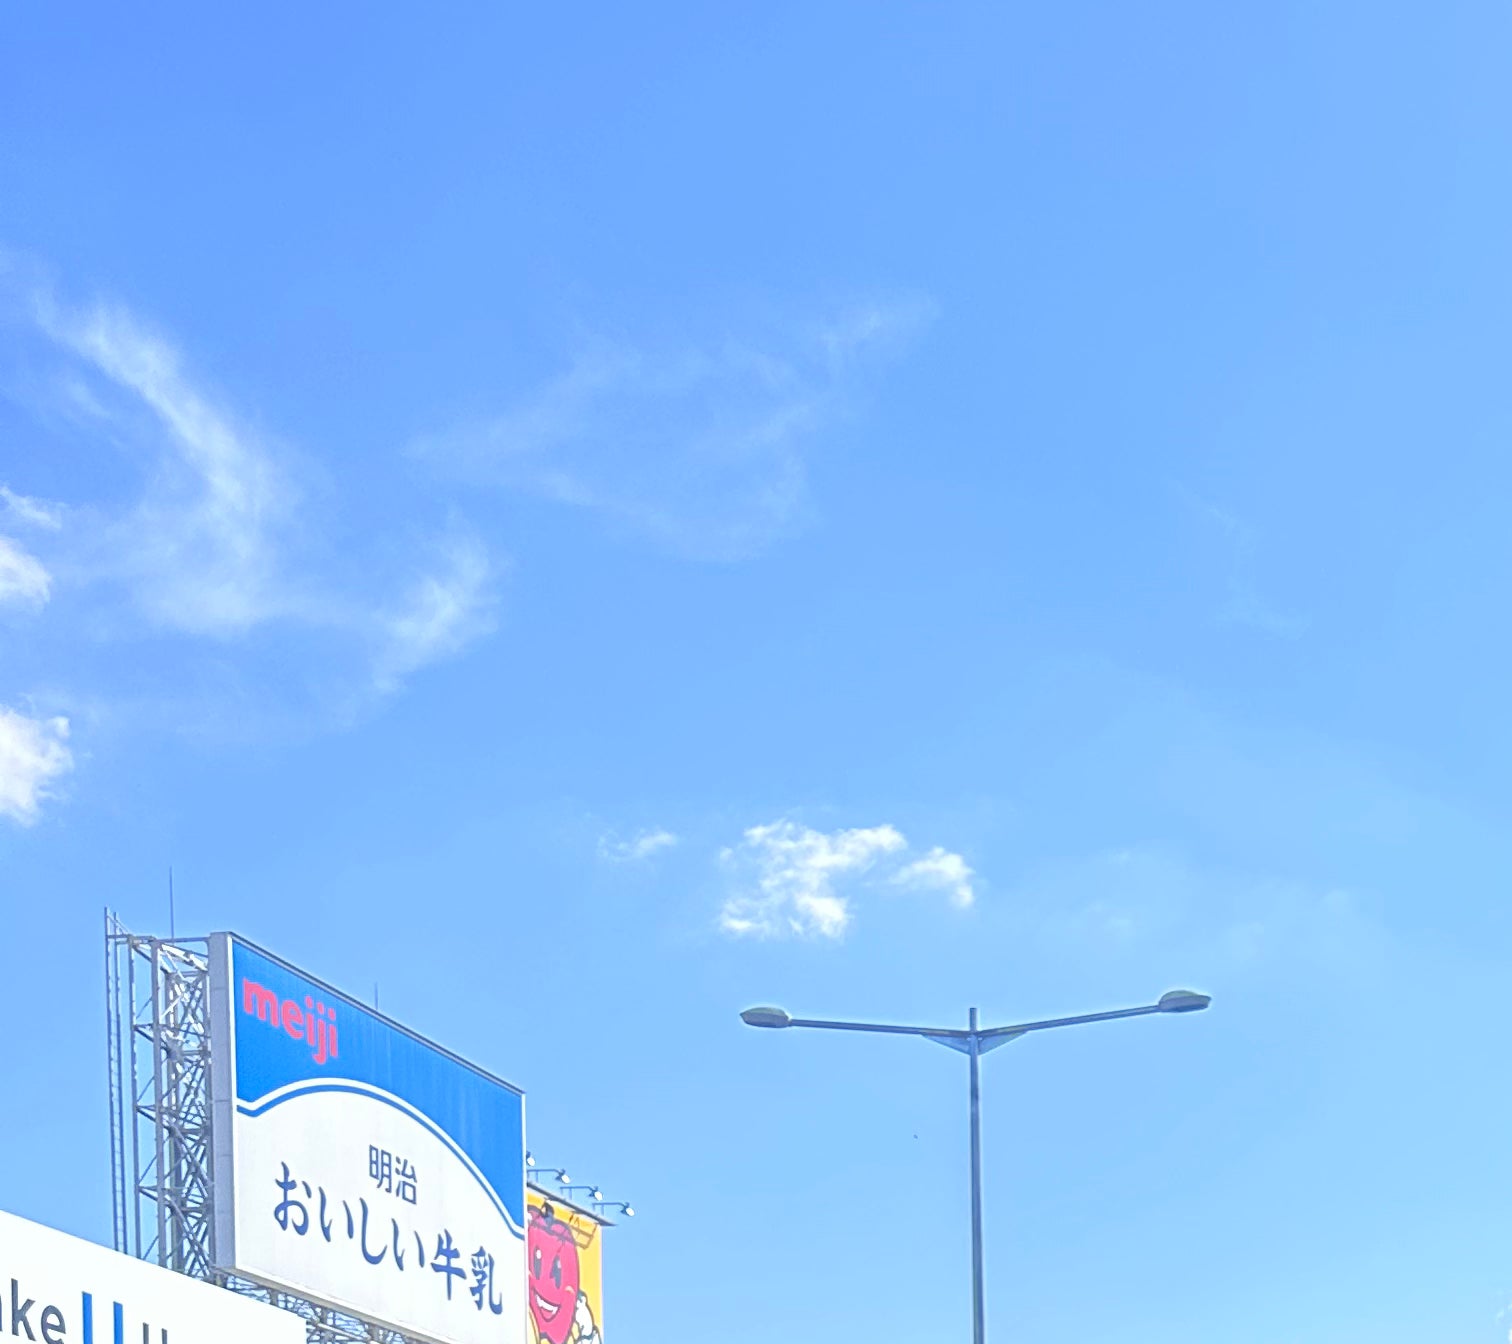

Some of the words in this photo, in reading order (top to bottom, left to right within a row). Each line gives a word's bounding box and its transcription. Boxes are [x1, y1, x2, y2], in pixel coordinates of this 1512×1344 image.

[243, 977, 339, 1065] meiji
[369, 1144, 418, 1205] 明治
[274, 1161, 503, 1315] おいしい牛乳
